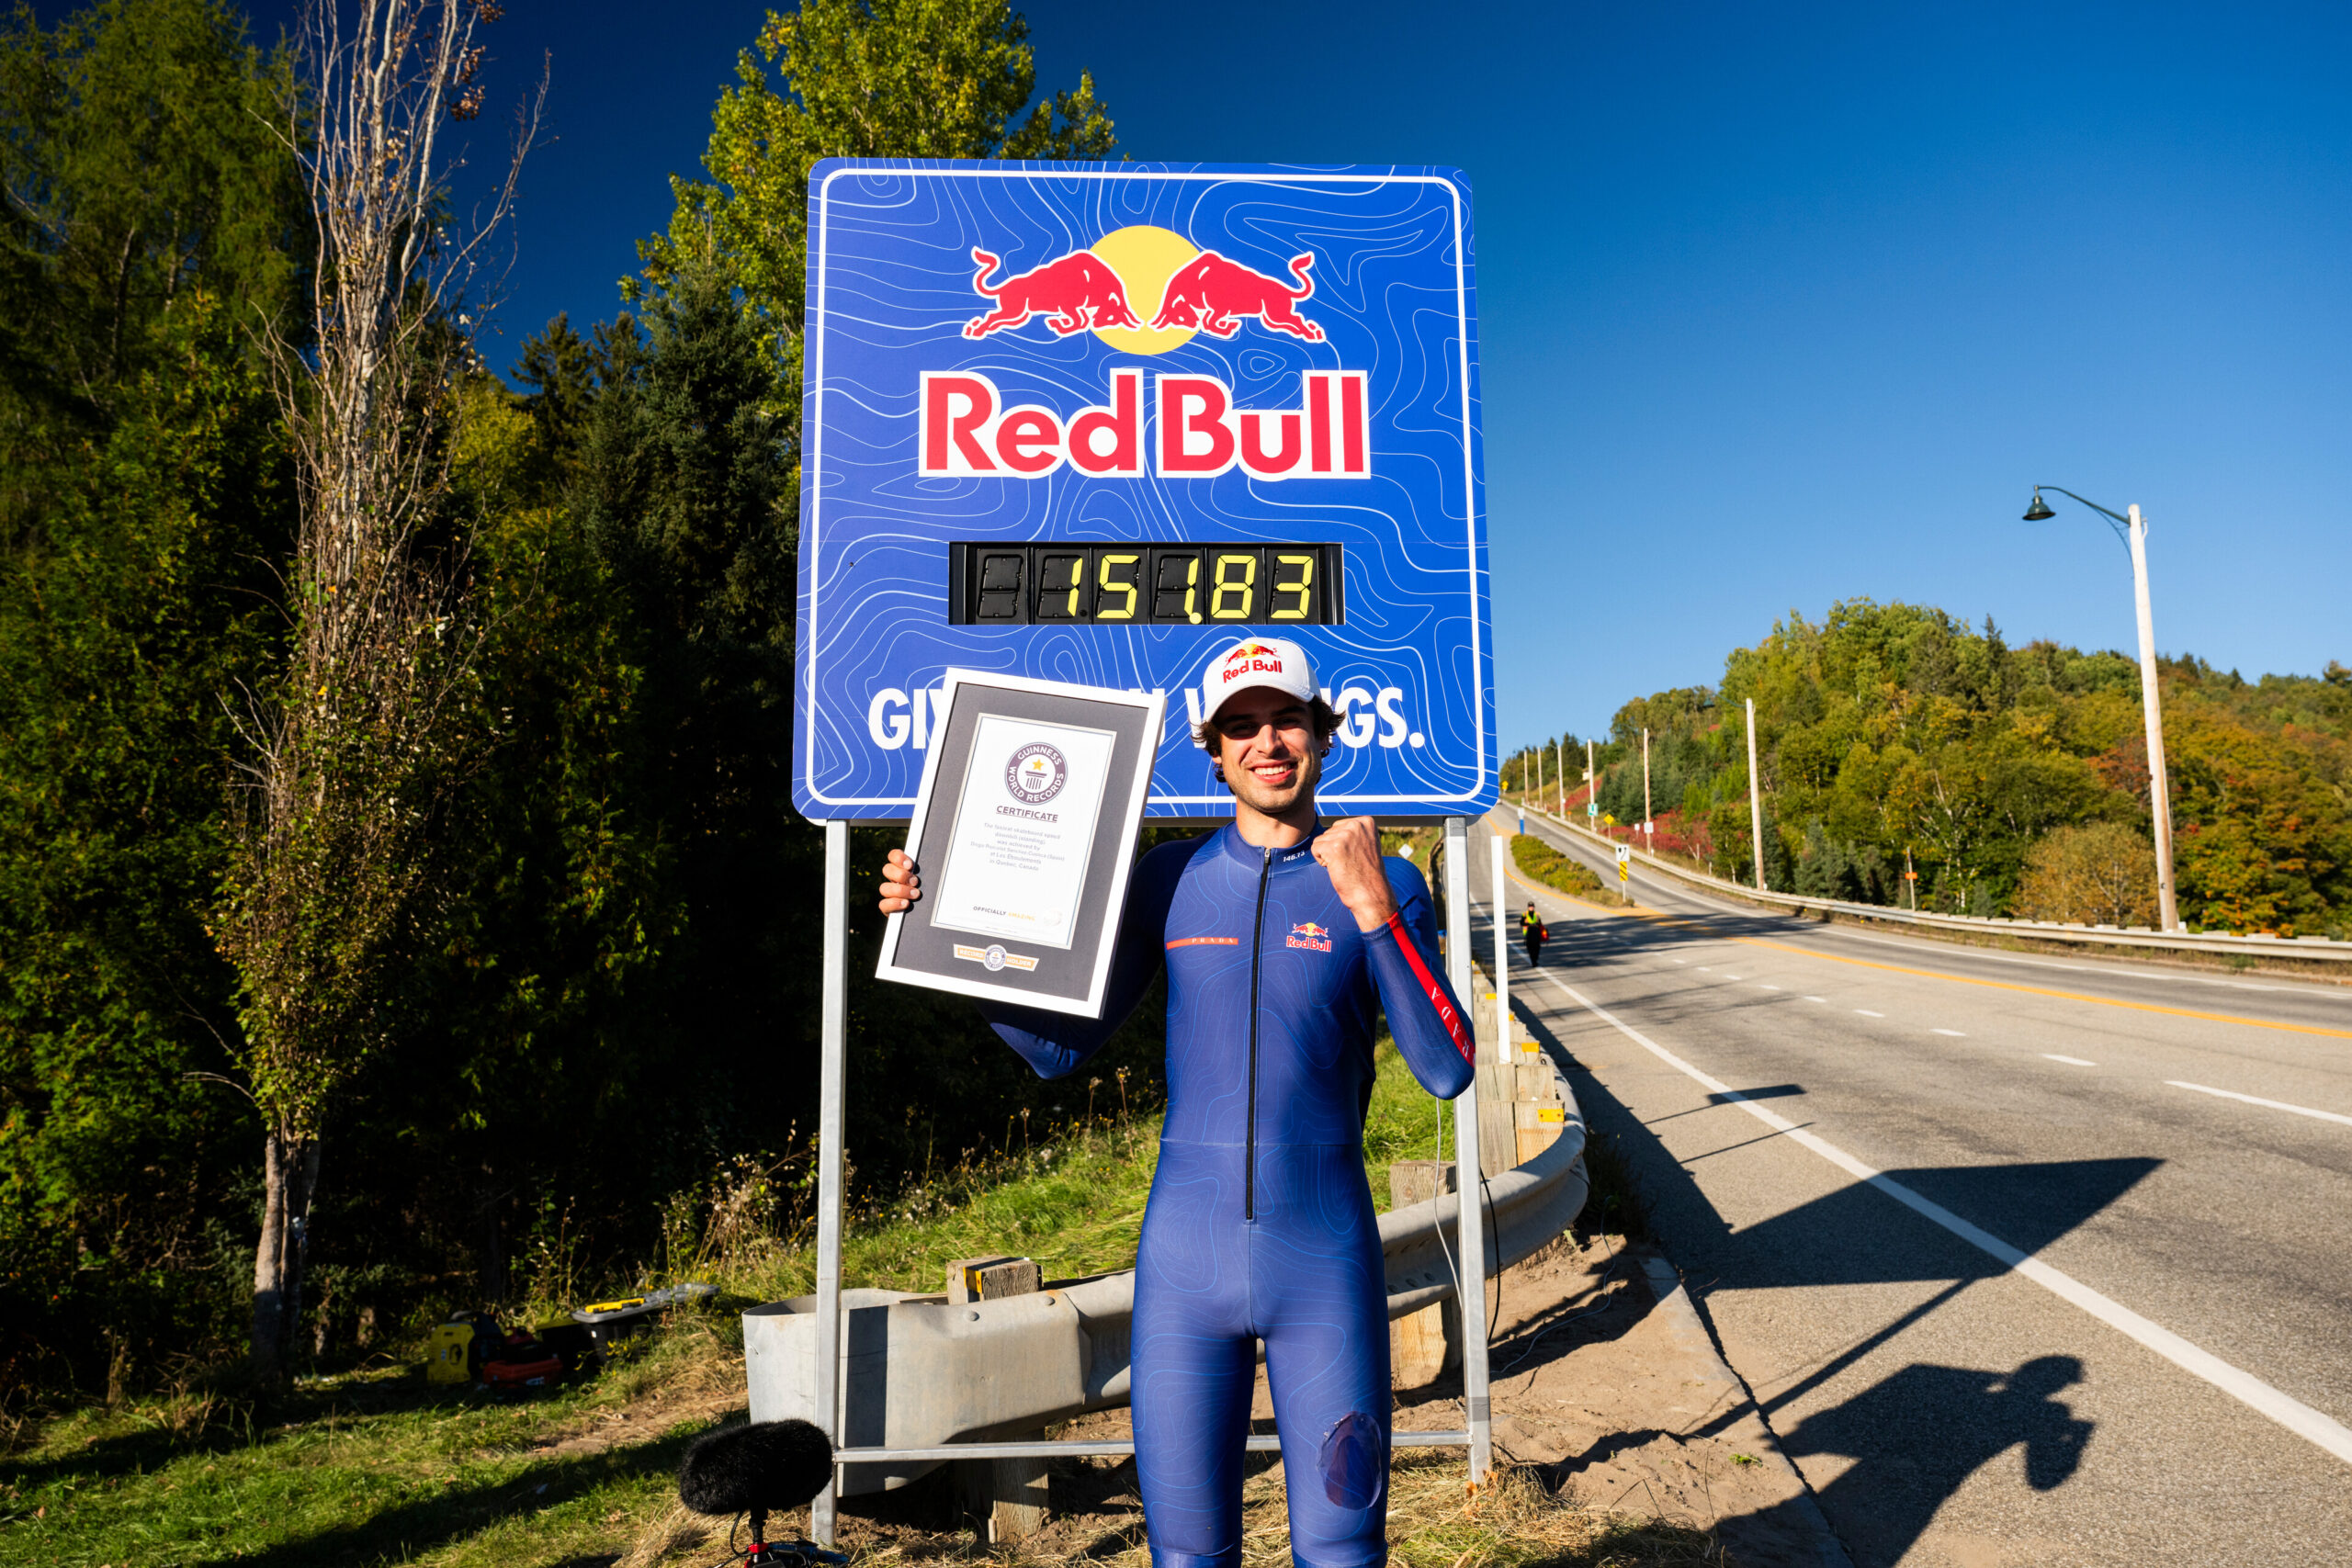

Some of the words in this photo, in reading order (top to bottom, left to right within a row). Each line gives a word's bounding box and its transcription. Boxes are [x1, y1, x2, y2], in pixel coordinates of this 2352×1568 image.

[924, 373, 1138, 474] Red
[1160, 375, 1366, 475] Bull
[1068, 555, 1314, 625] 151.83
[1223, 660, 1250, 683] Red
[1252, 660, 1283, 673] Bull
[1017, 745, 1062, 766] GUINNESS
[1008, 765, 1025, 798] WORLD
[1026, 773, 1064, 802] RECORDS
[996, 805, 1058, 822] CERTIFICATE
[973, 906, 1007, 916] OFFICIALLY
[1286, 935, 1309, 949] Red
[1309, 938, 1332, 953] Bull
[1006, 957, 1032, 966] HOLDER
